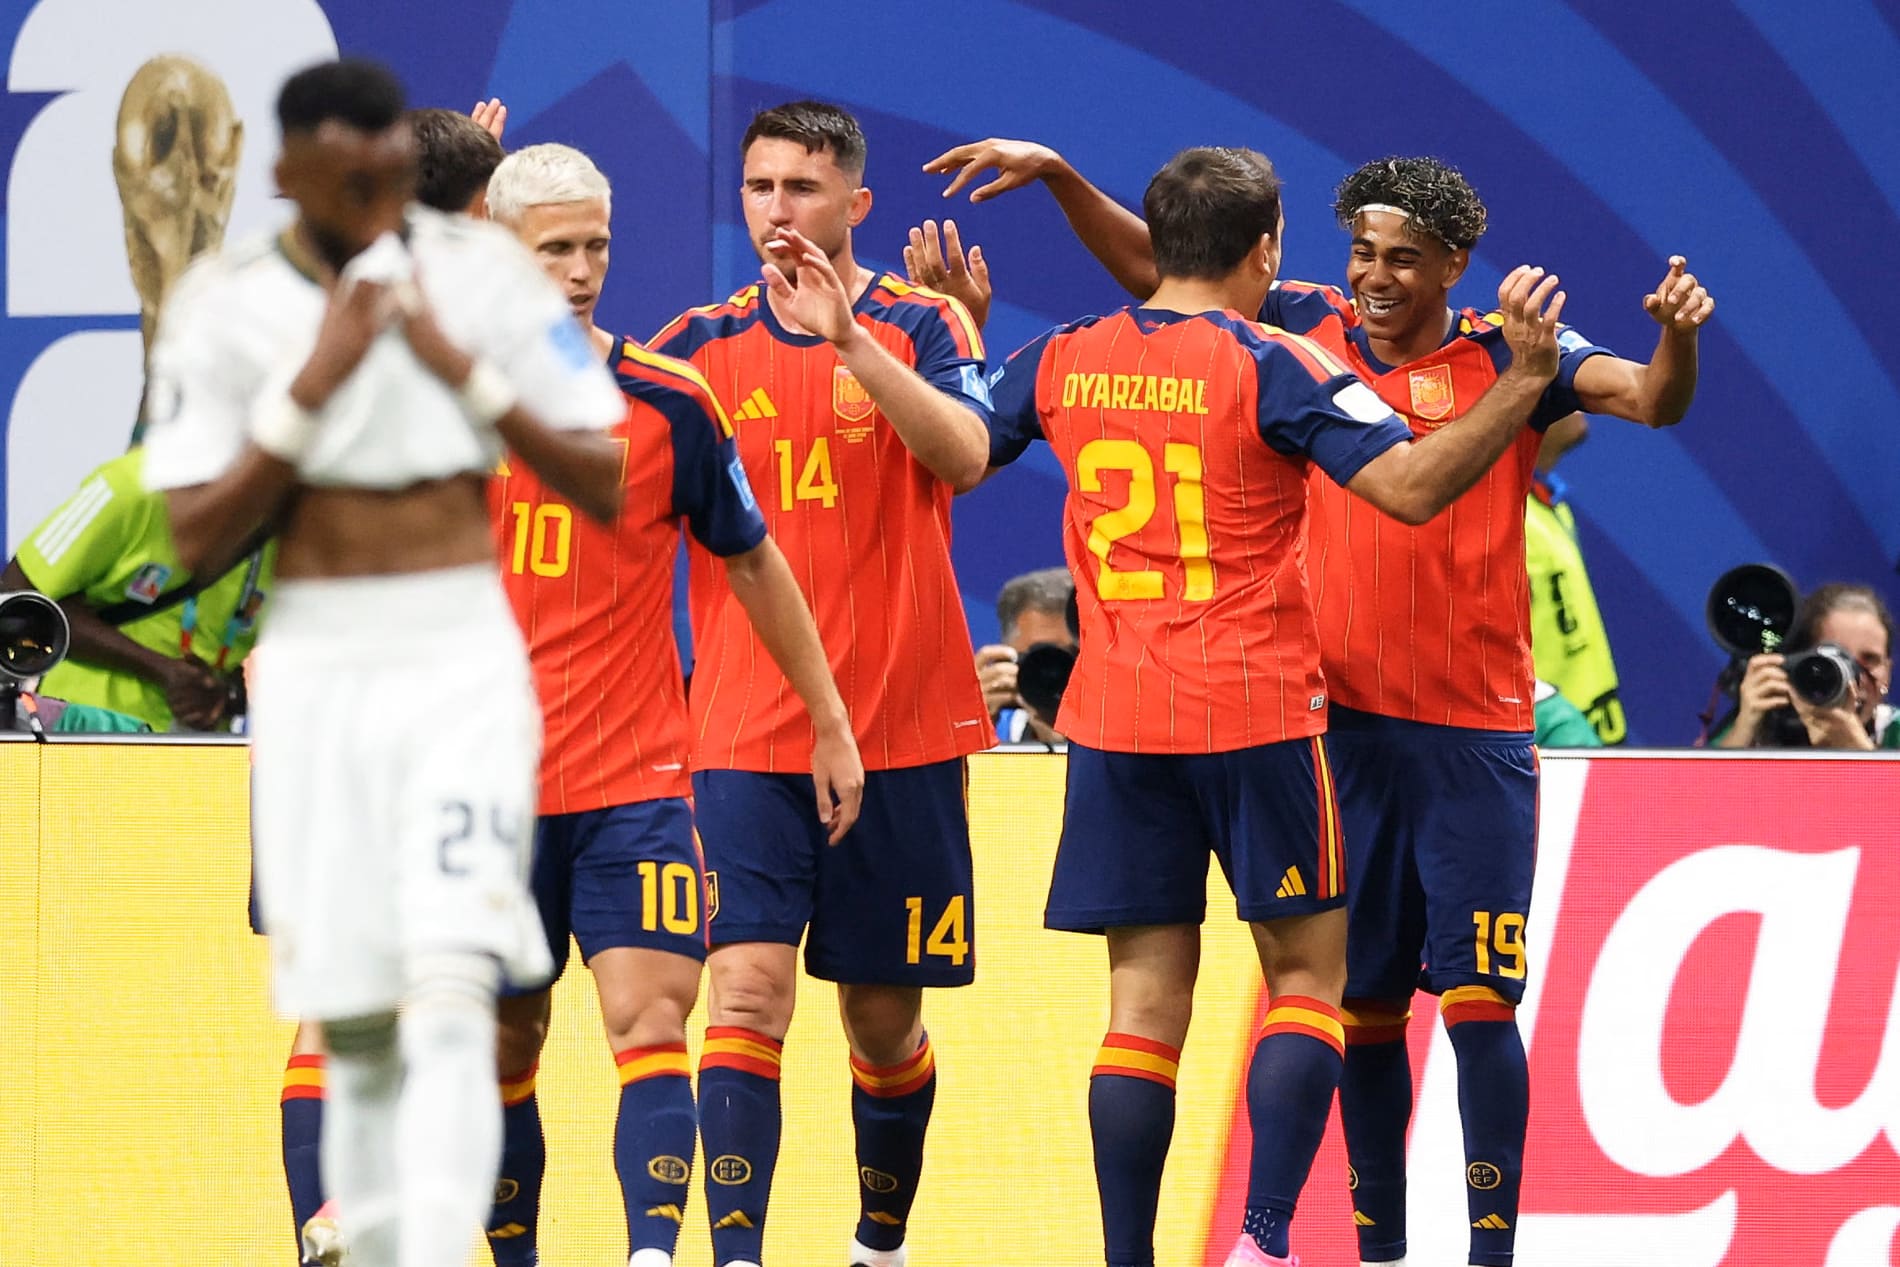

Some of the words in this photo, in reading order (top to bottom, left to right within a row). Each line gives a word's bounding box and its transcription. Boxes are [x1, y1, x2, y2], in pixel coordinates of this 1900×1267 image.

[1062, 373, 1209, 414] OYARZABAL
[775, 437, 838, 511] 14
[512, 502, 572, 578] 10
[1077, 439, 1215, 602] 21
[638, 861, 698, 935] 10
[905, 895, 969, 966] 14
[1473, 911, 1527, 979] 19
